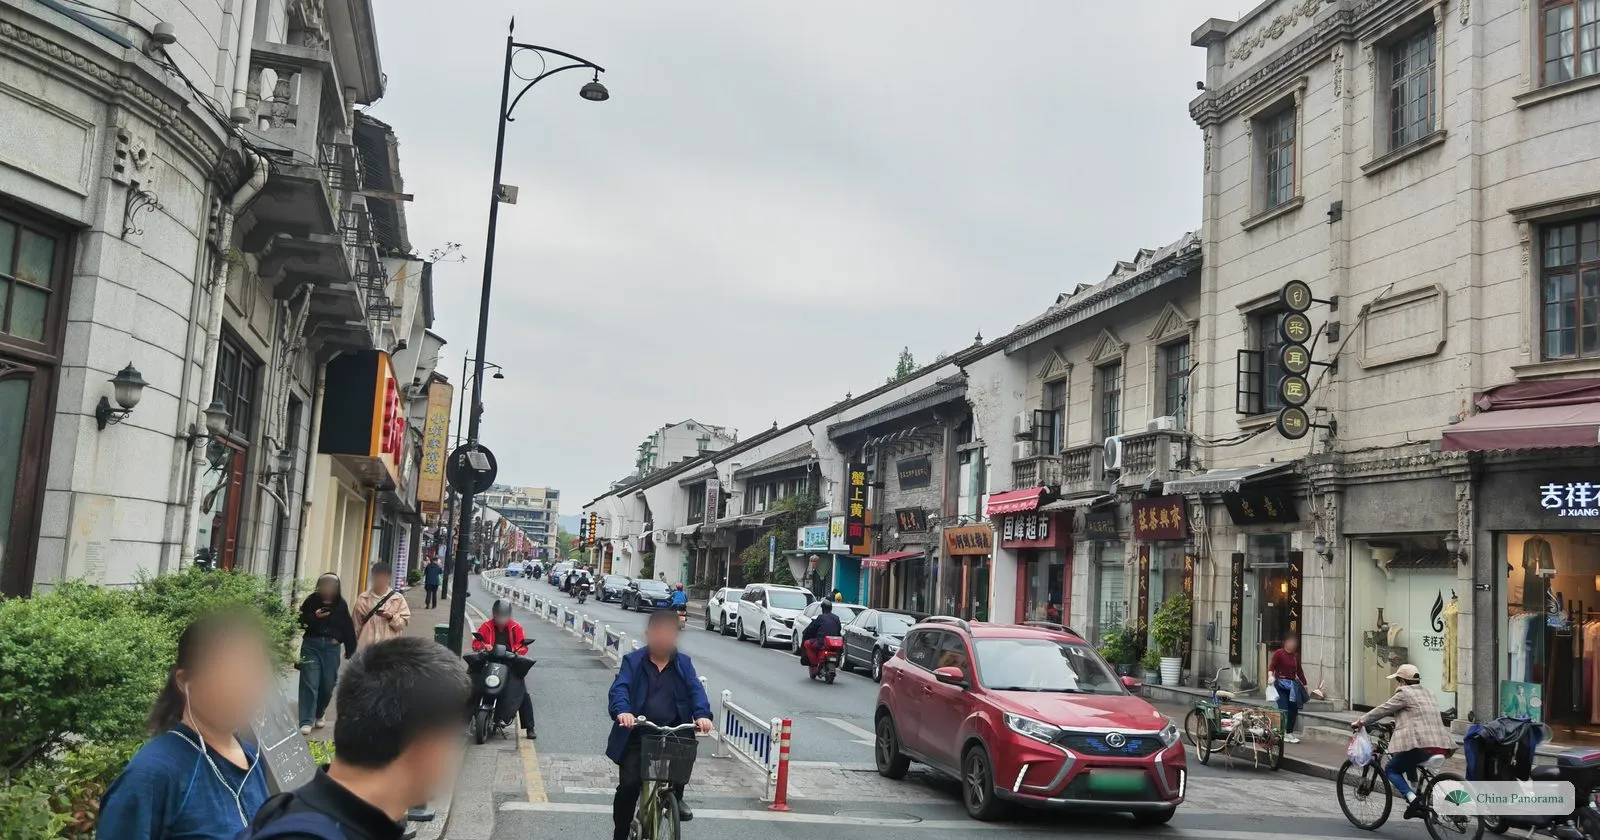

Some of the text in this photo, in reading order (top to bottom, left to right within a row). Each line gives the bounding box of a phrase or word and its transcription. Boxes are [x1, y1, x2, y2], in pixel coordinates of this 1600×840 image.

[1558, 508, 1599, 517] JI XIANG
[1003, 513, 1049, 541] 国峰超市
